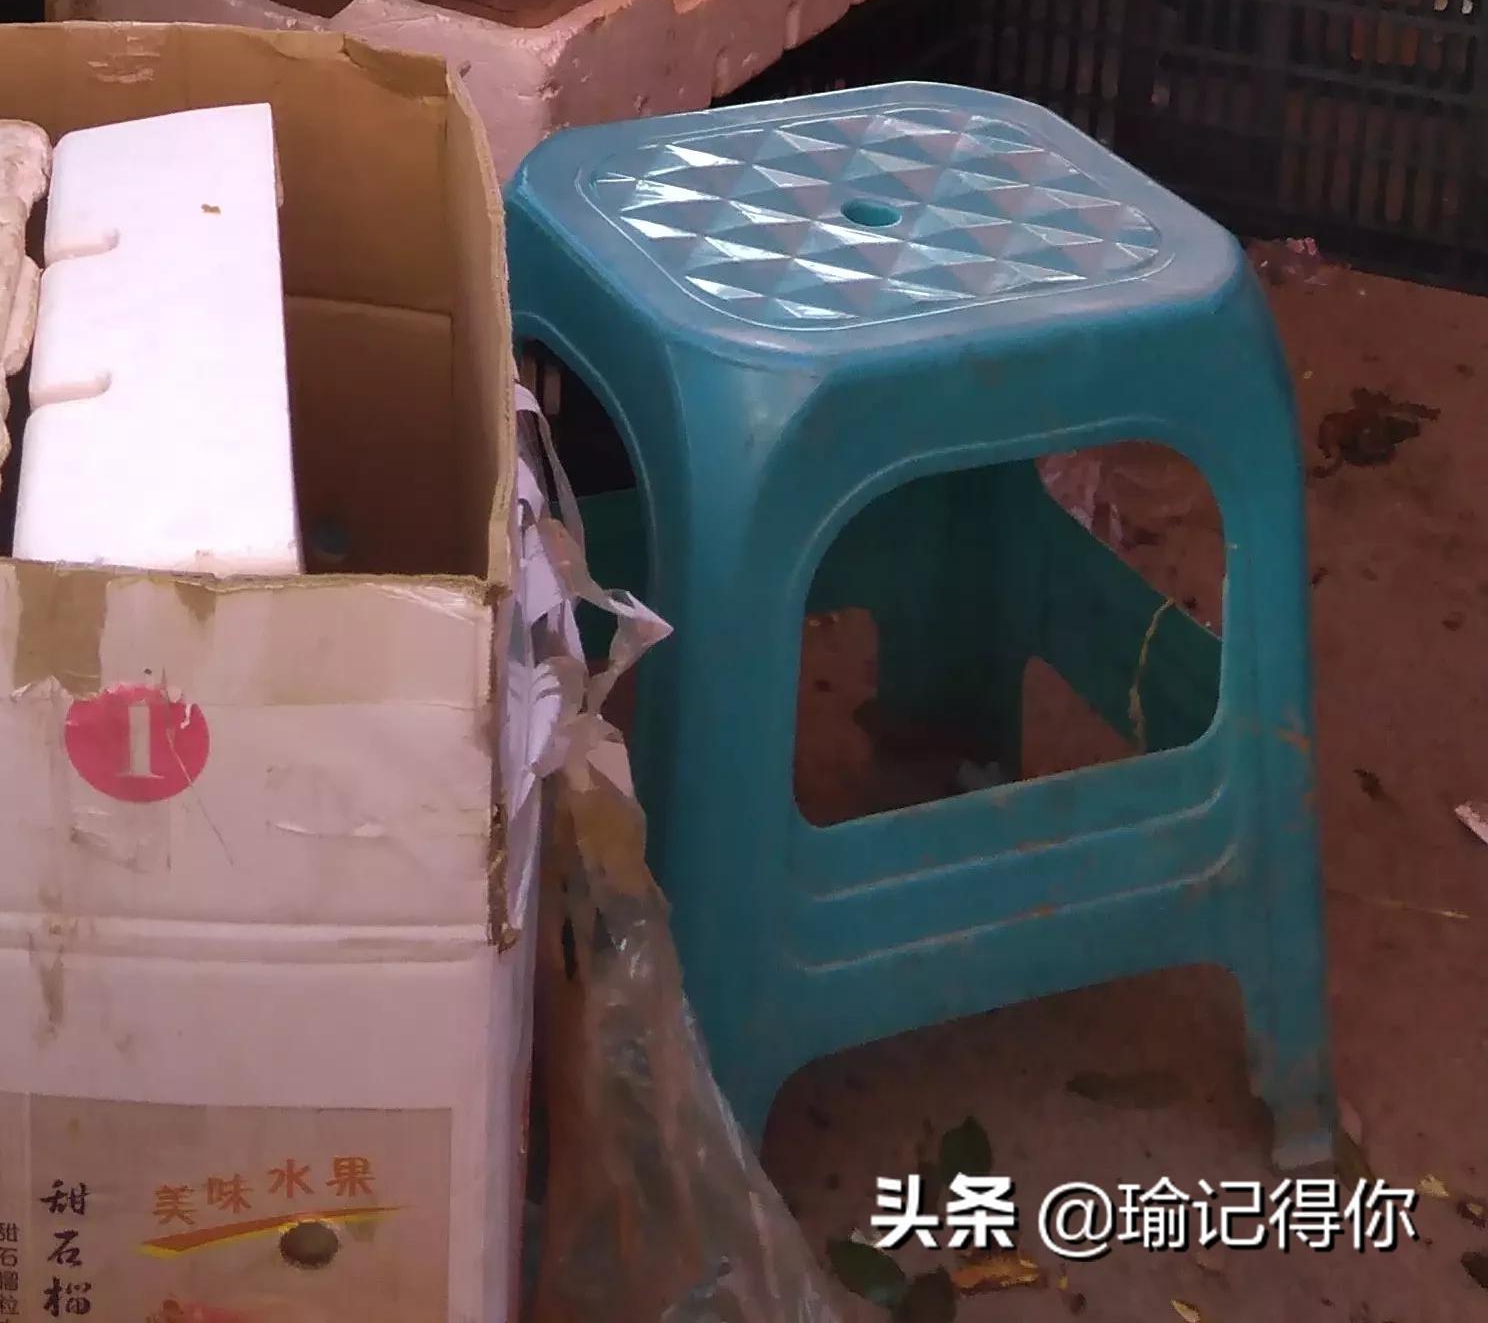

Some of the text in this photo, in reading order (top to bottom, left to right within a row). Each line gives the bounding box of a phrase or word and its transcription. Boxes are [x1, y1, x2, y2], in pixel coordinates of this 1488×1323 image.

[115, 698, 165, 779] 1
[153, 1156, 375, 1225] 美味水果
[40, 1179, 93, 1318] 甜石榴
